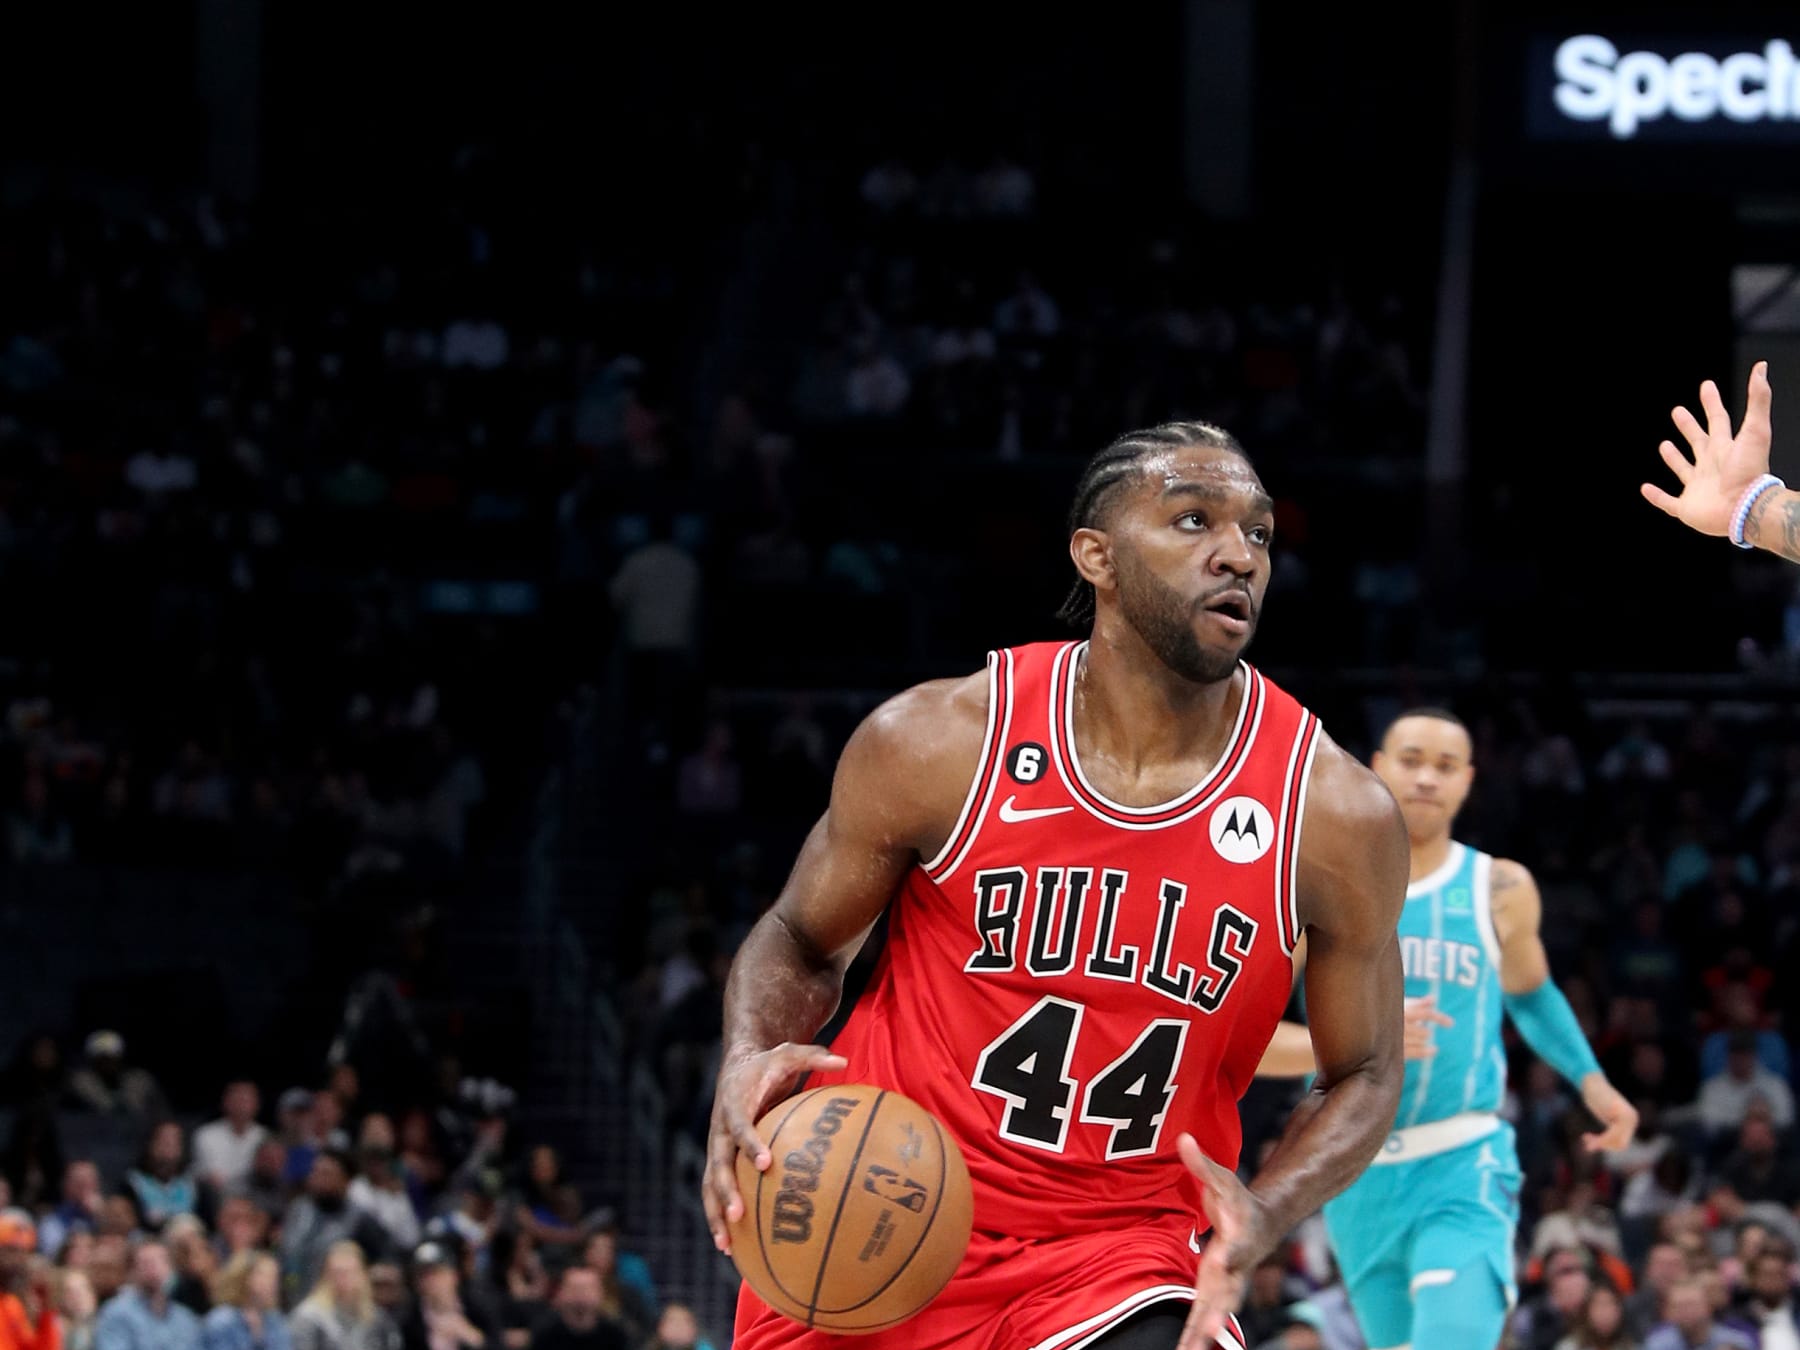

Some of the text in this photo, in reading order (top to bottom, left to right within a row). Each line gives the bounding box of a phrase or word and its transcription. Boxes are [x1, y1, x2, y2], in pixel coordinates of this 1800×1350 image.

[1015, 748, 1041, 781] 6
[963, 866, 1259, 1014] BULLS
[1399, 936, 1480, 988] NETS
[971, 994, 1191, 1162] 44
[771, 1097, 861, 1245] Wilson
